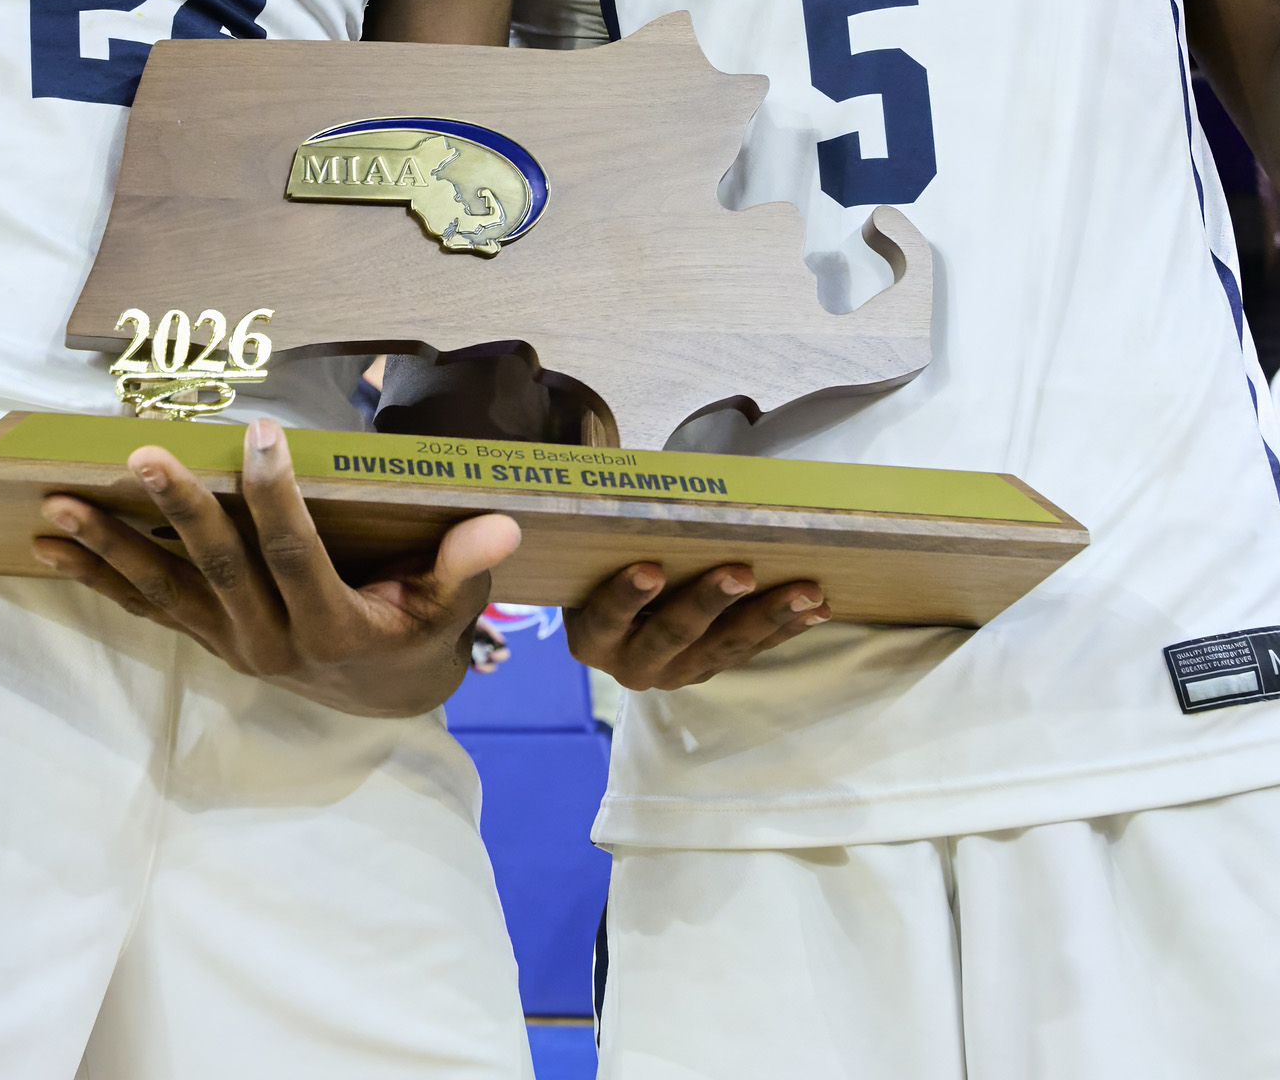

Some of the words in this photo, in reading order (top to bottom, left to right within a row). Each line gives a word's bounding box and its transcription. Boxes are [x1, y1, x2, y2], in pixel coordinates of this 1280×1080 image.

[301, 154, 429, 187] MIAA
[109, 308, 276, 375] 2026
[416, 441, 468, 456] 2026
[476, 445, 525, 461] Boys
[532, 448, 638, 467] Basketball
[333, 454, 455, 479] DIVISION
[465, 463, 482, 480] II
[492, 465, 572, 486] STATE
[581, 469, 728, 496] CHAMPION
[1176, 648, 1203, 659] QUALITY
[1178, 656, 1205, 667] PRODUCT
[1238, 647, 1251, 658] THE
[1181, 662, 1212, 674] GREATEST
[1213, 658, 1235, 669] PLAYER
[1235, 655, 1253, 666] EVER
